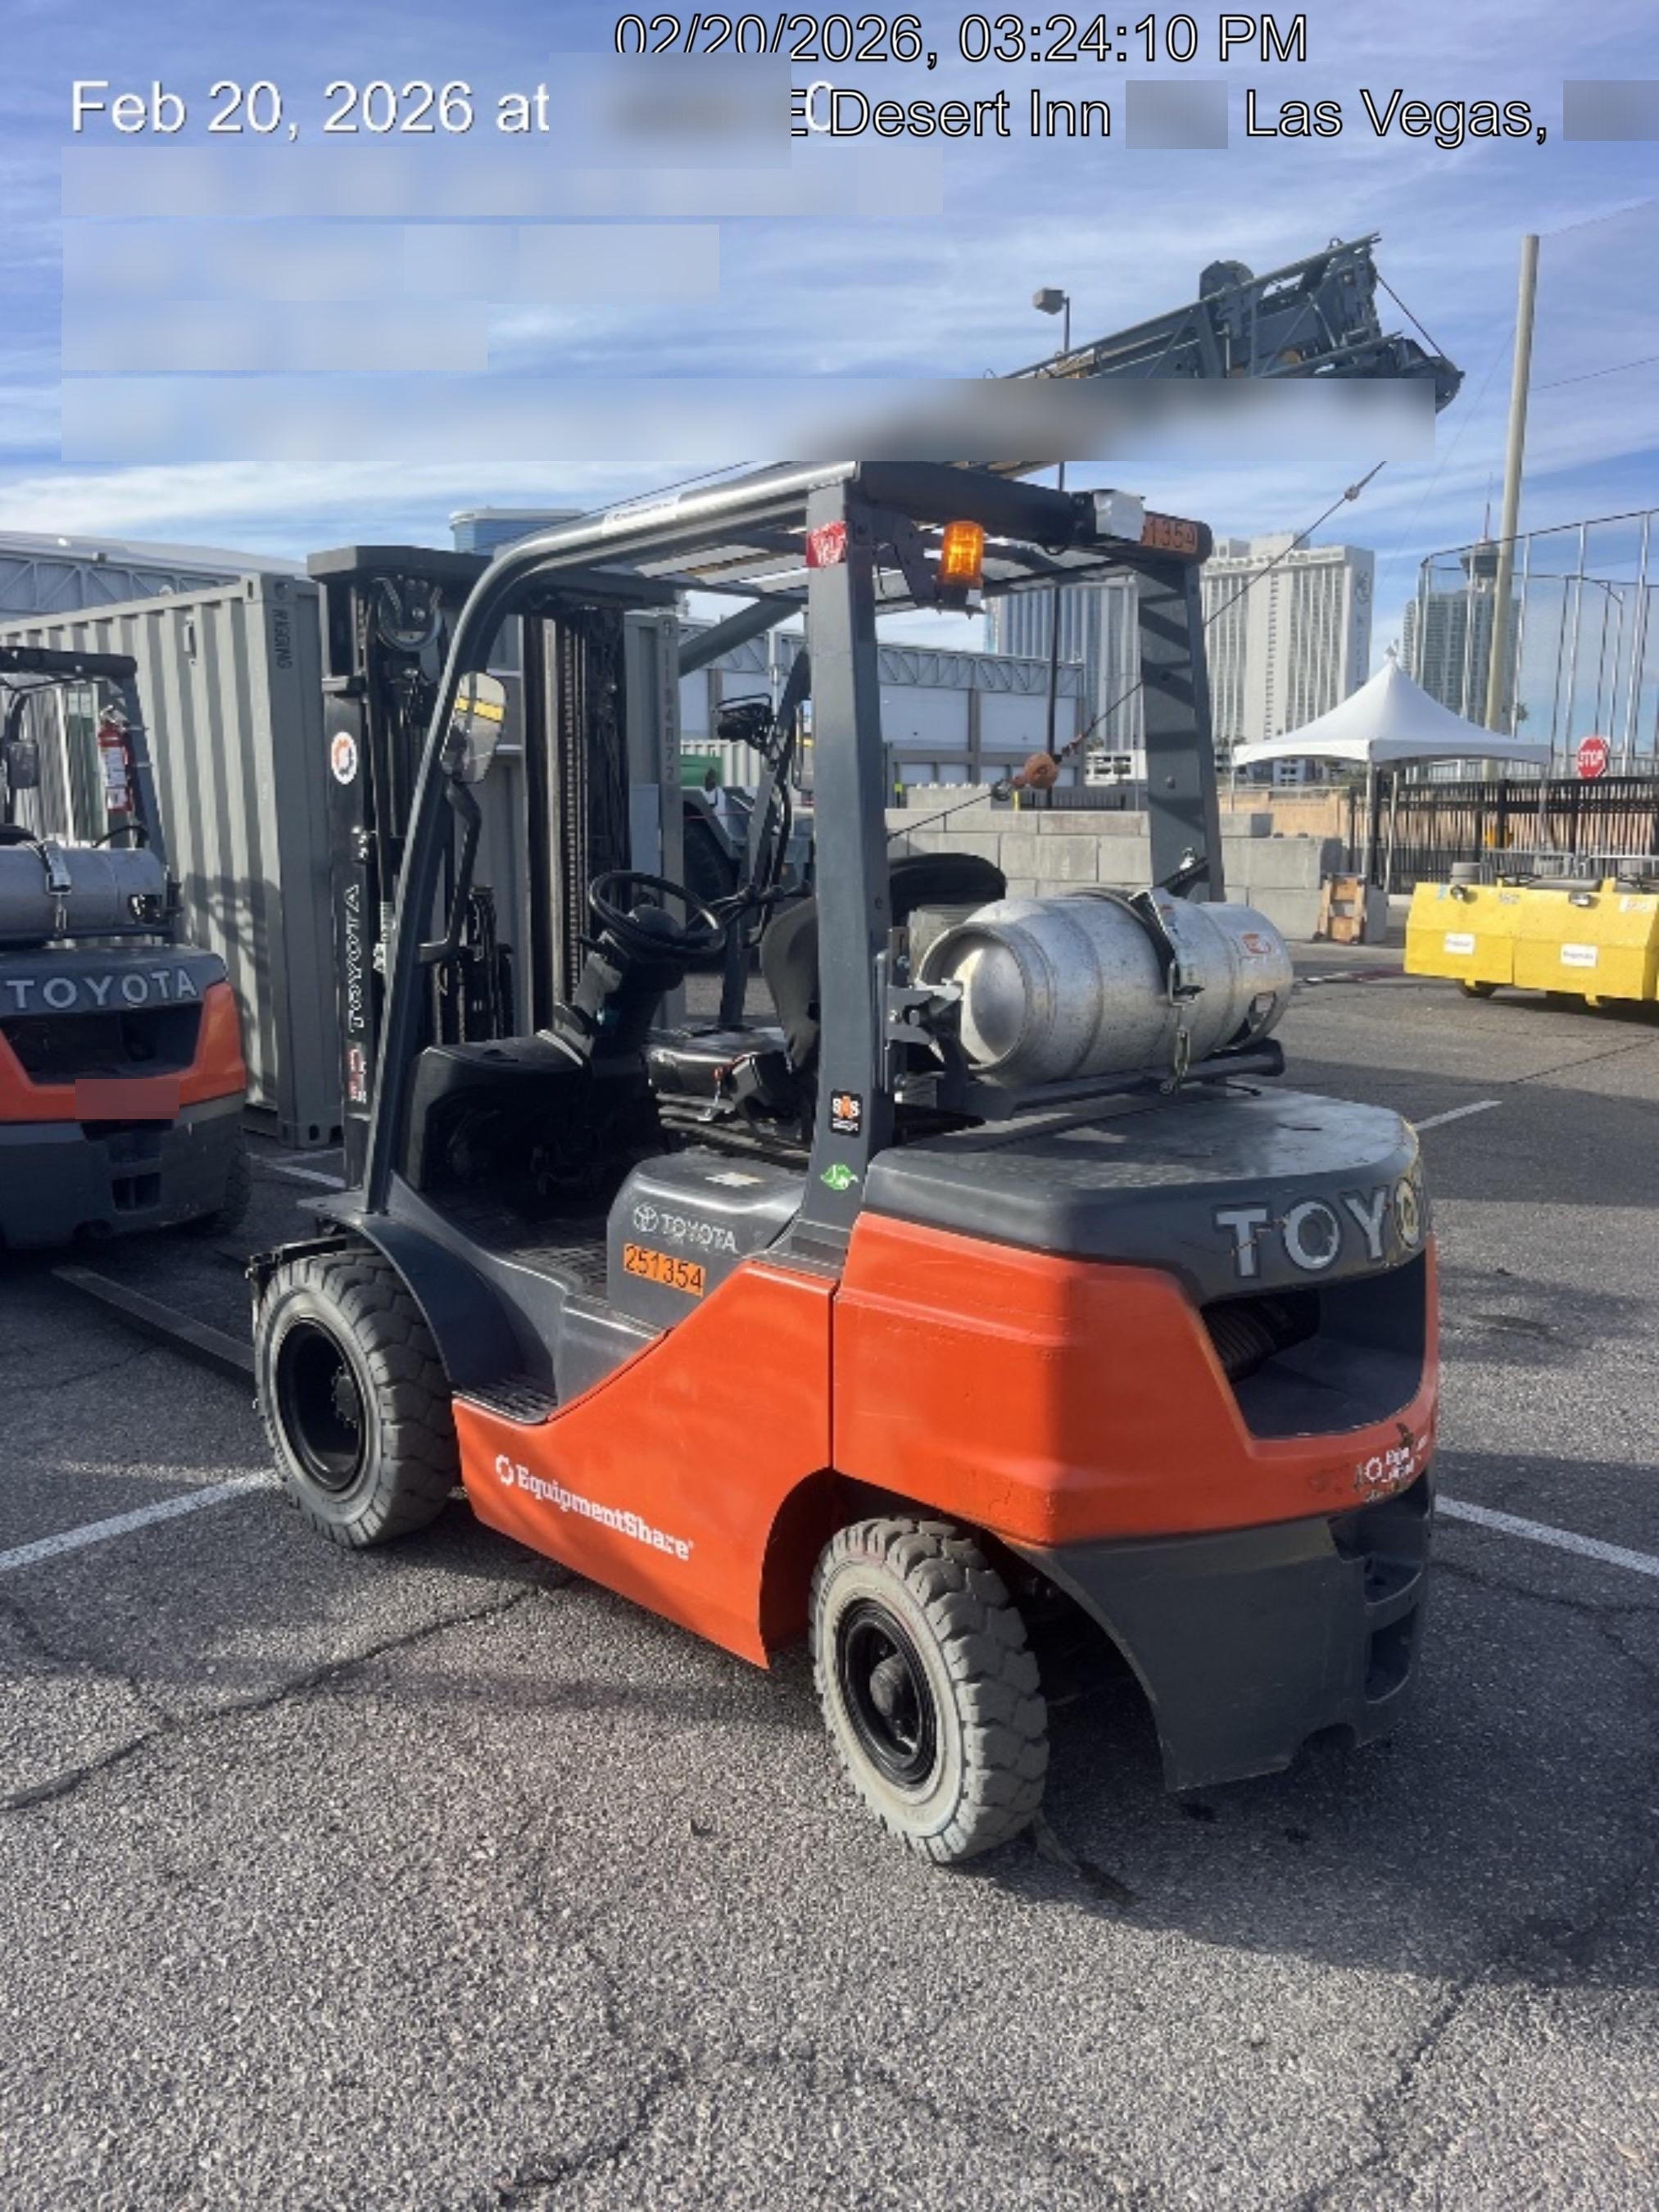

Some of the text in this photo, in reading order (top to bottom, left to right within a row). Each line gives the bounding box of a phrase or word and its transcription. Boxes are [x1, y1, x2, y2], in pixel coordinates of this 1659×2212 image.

[1578, 750, 1605, 768] STOP
[345, 884, 365, 1033] TOYOTA
[6, 969, 197, 1009] TOYOTA
[660, 1213, 739, 1254] TOYOTA
[625, 1245, 702, 1290] 251354
